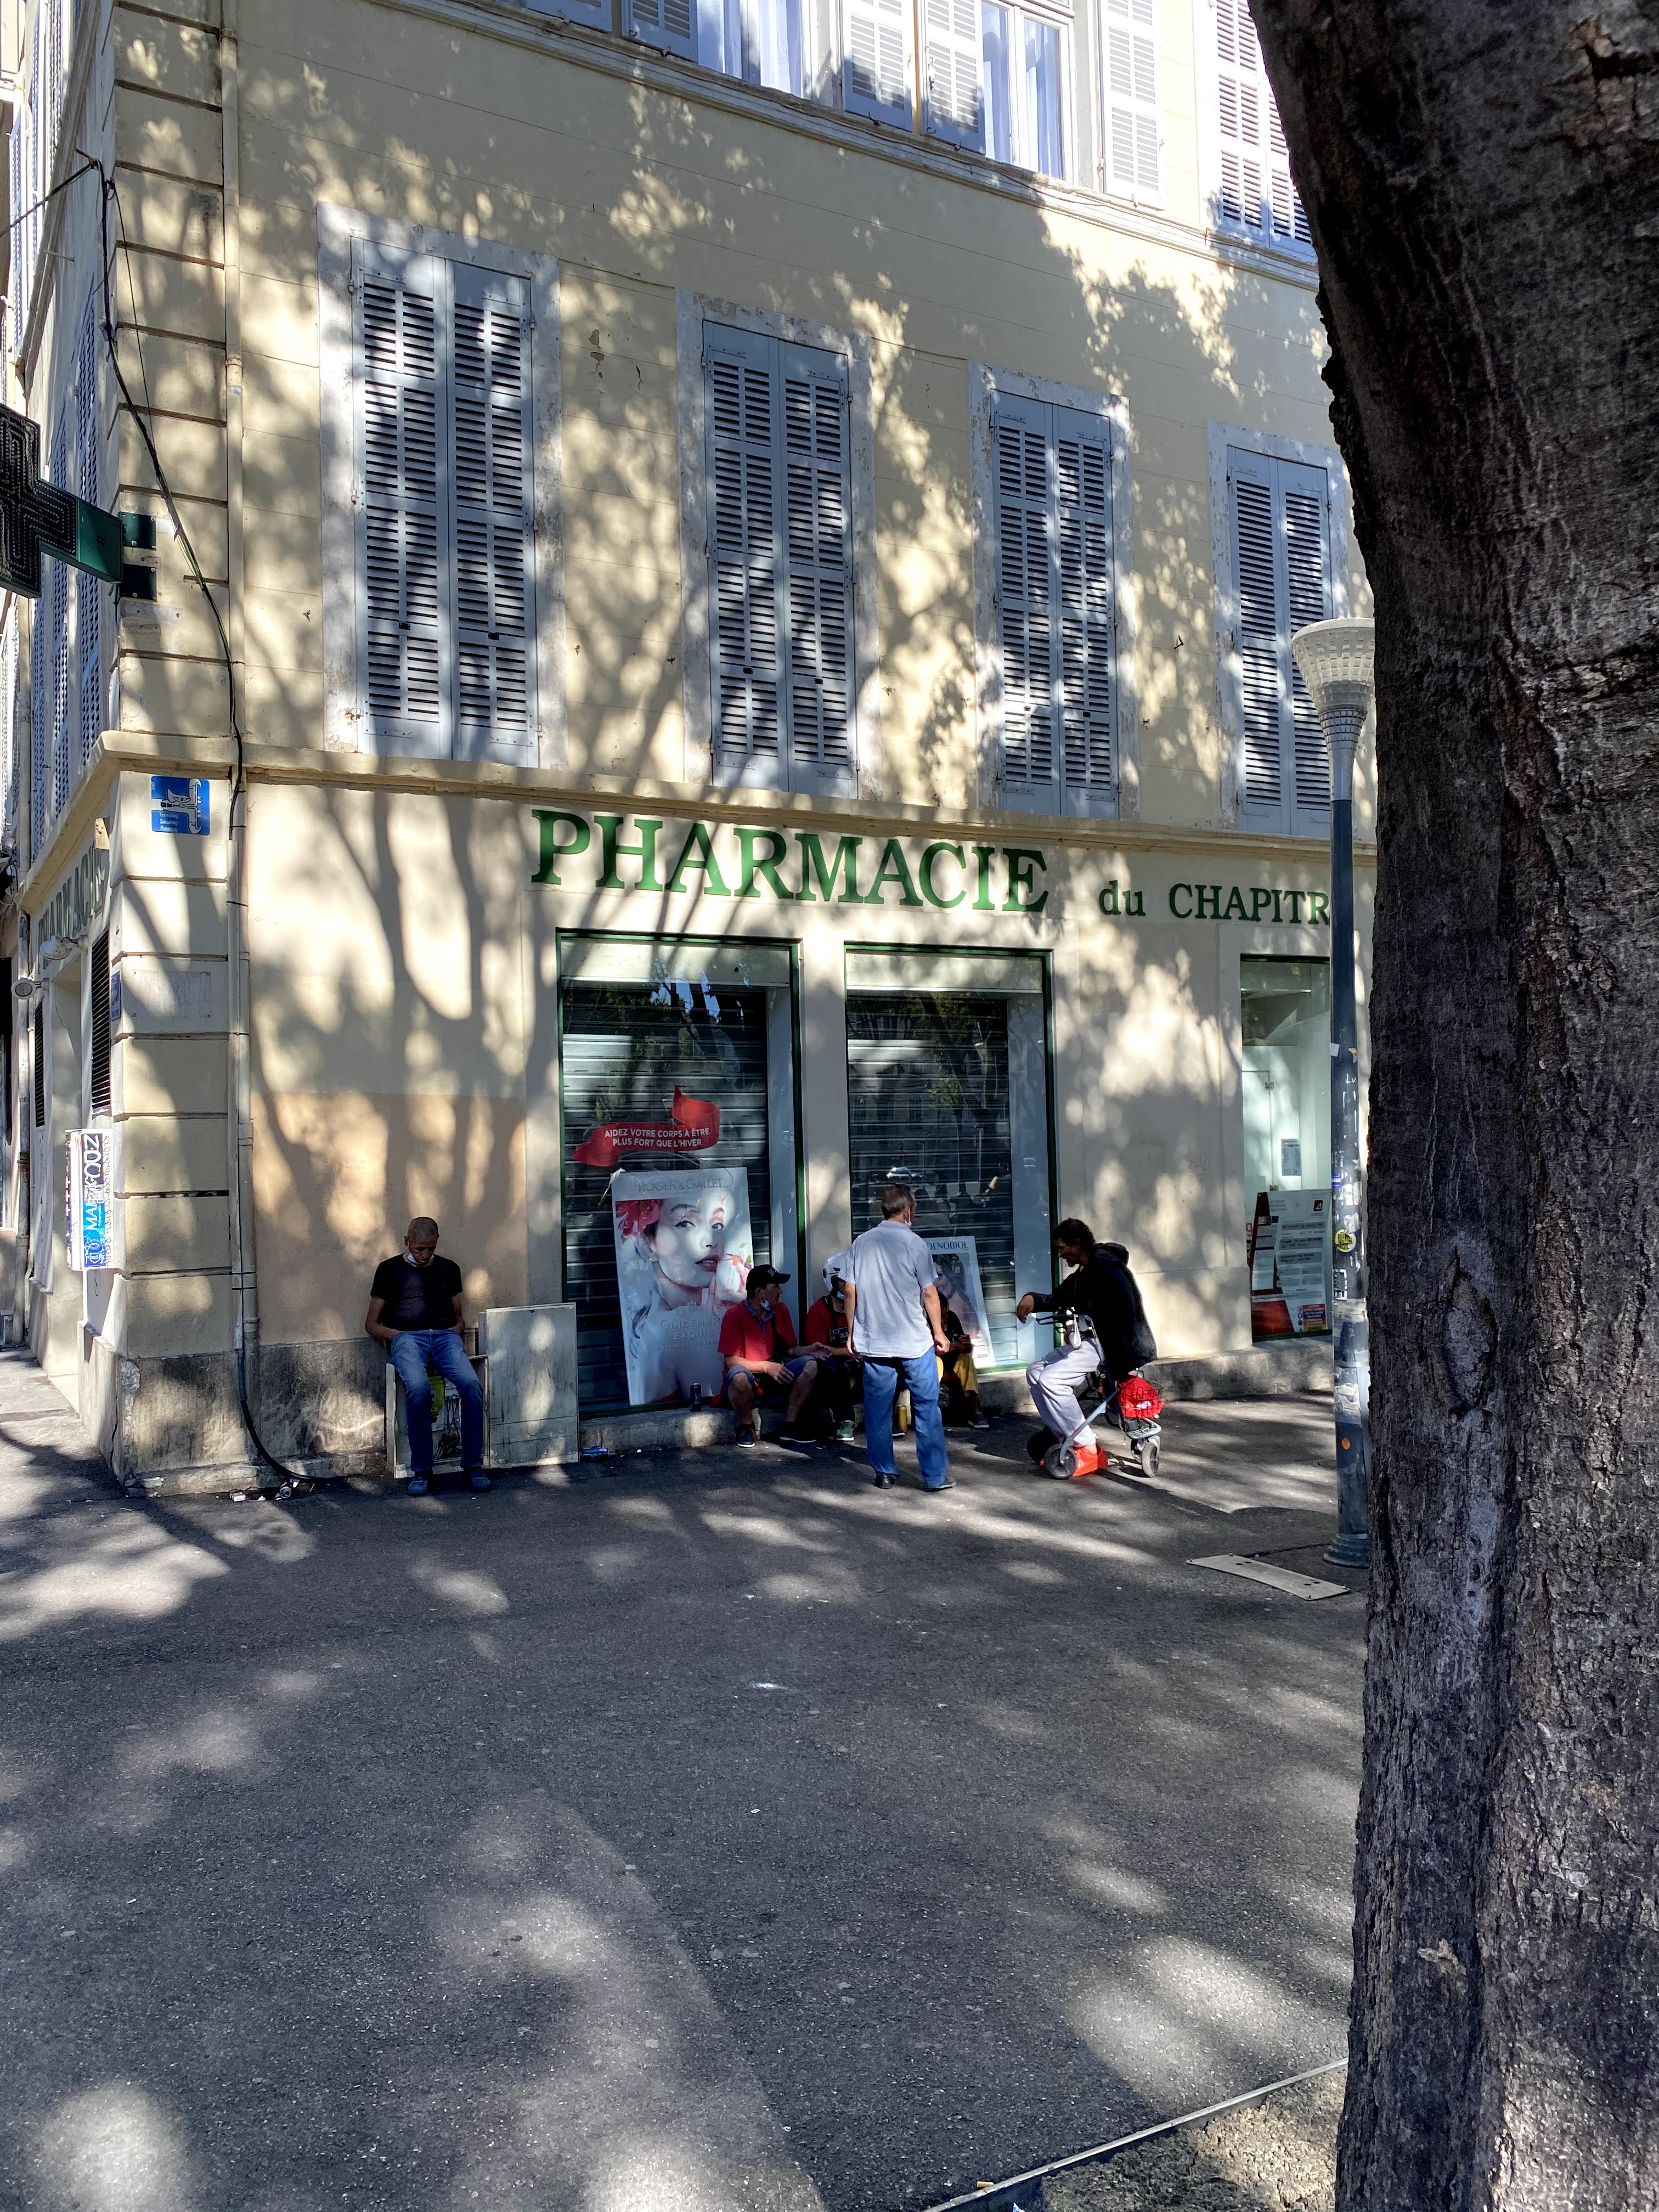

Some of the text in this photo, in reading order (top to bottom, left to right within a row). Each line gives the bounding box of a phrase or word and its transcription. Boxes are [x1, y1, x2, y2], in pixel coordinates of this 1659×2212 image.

[531, 809, 1048, 912] PHARMACIE
[1098, 879, 1330, 926] du CHAPITR
[605, 1128, 628, 1138] AIDEZ
[630, 1128, 656, 1137] VOTRE
[657, 1130, 682, 1138] CORPS
[691, 1127, 710, 1137] ÊTRE
[656, 1139, 672, 1148] QUE
[674, 1138, 702, 1148] L'HIVER
[661, 1318, 719, 1330] GINGEMBR
[674, 1329, 714, 1340] EXQUIS
